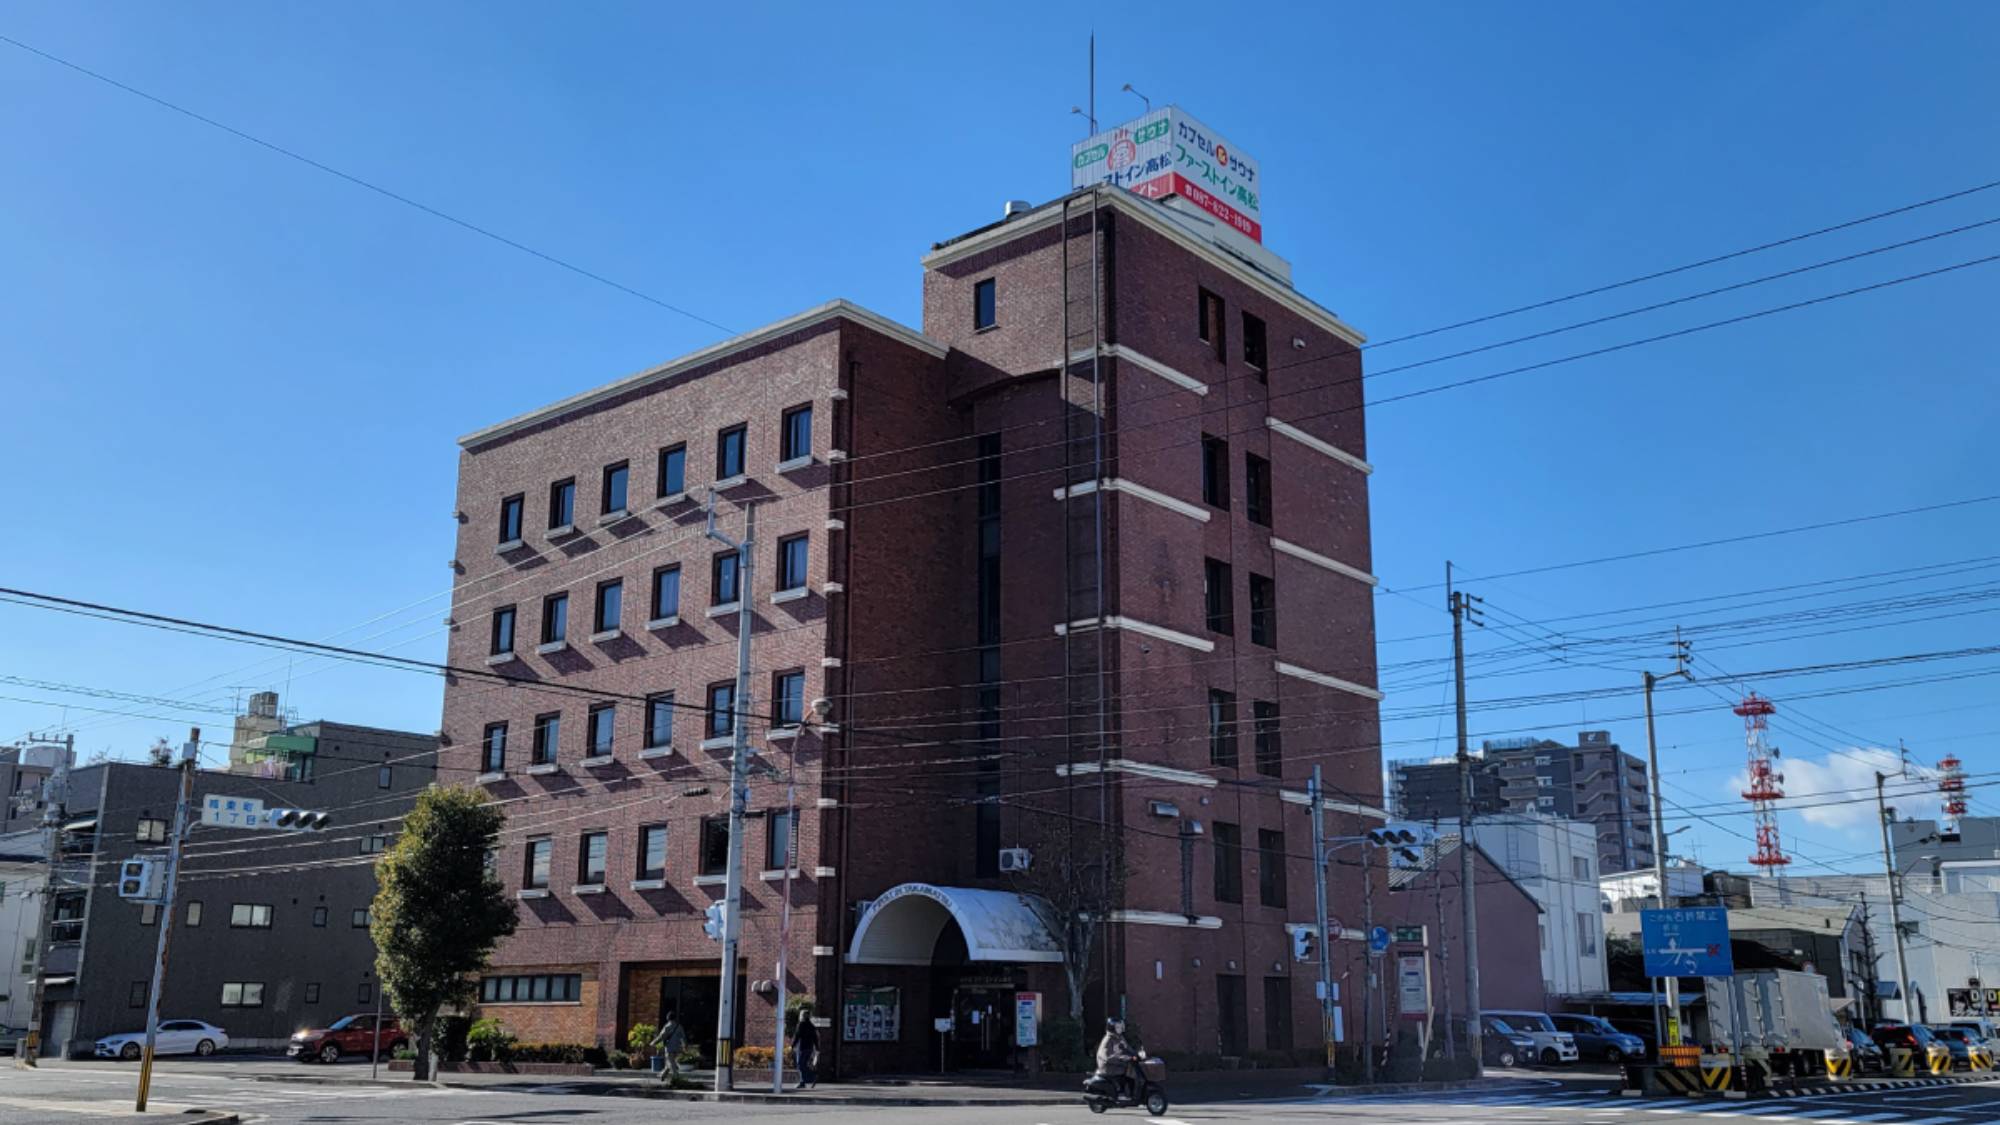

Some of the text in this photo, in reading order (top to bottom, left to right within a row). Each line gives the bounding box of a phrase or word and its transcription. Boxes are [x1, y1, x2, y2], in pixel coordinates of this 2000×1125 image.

[1175, 143, 1259, 211] ファーストイン高松
